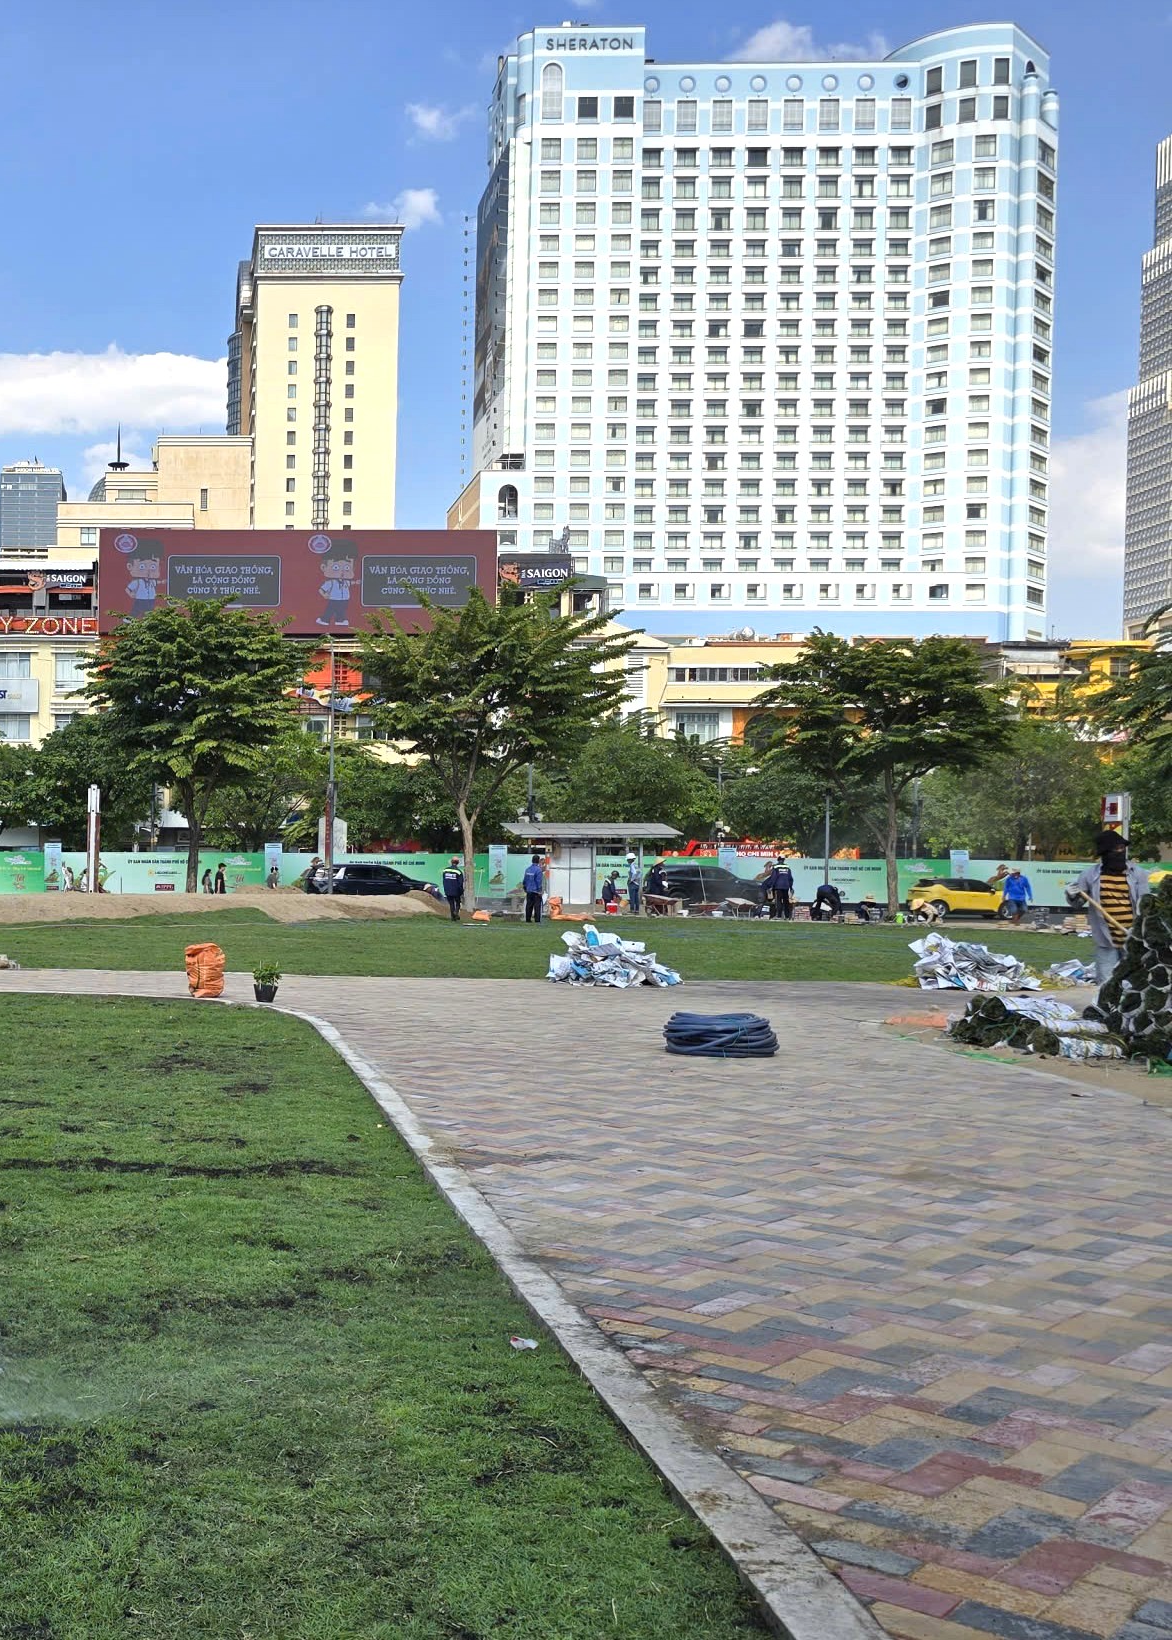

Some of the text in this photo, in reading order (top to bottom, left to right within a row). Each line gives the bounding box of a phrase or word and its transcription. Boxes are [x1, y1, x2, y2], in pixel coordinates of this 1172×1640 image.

[546, 38, 633, 50] SHERATON
[268, 246, 392, 258] CARAVELLE HOTEL
[175, 564, 194, 574] VĂN
[195, 565, 212, 574] HÓA
[369, 564, 388, 574] VĂN
[390, 565, 408, 574] HÓA
[527, 568, 568, 578] SAIGON
[51, 574, 86, 583] SAIGON
[24, 617, 96, 634] ZONE
